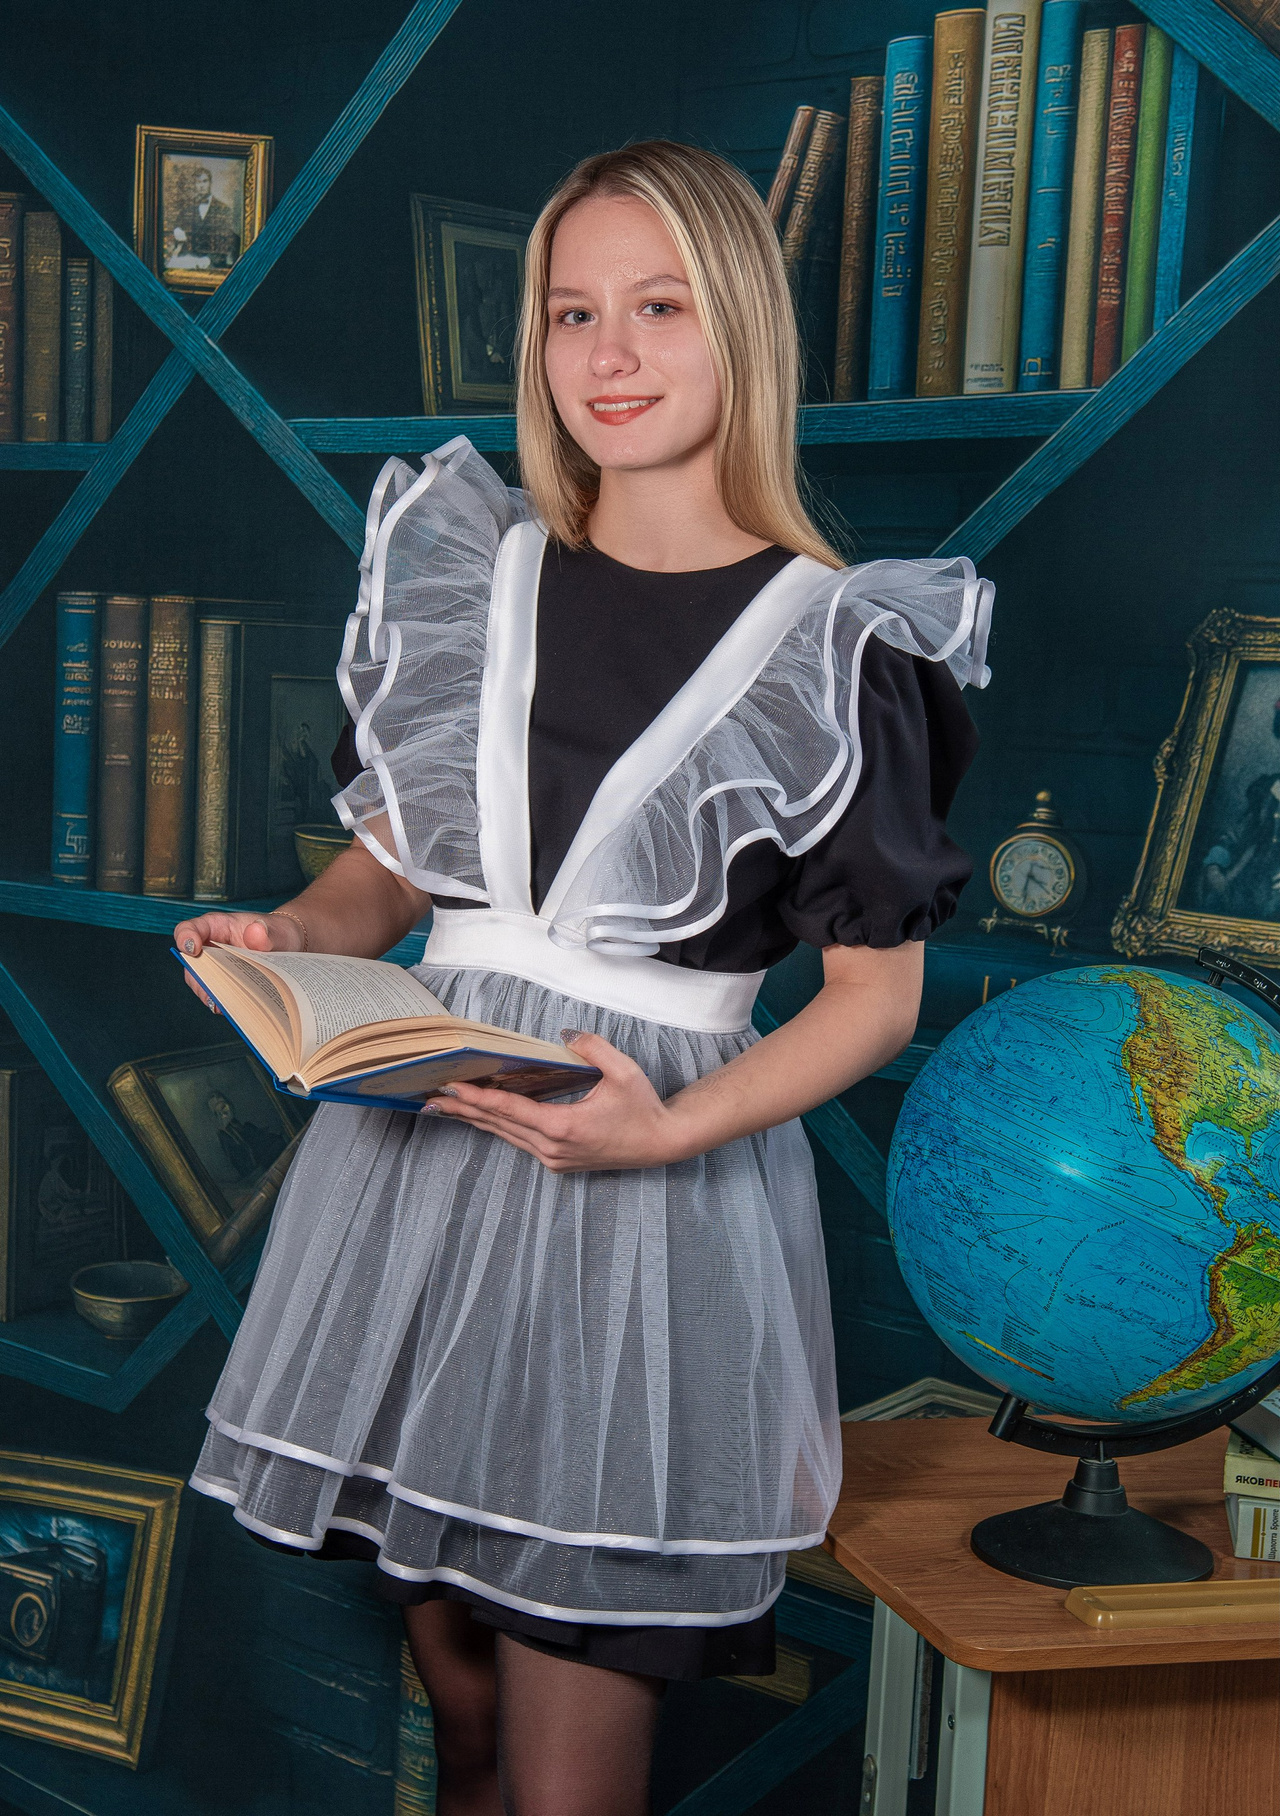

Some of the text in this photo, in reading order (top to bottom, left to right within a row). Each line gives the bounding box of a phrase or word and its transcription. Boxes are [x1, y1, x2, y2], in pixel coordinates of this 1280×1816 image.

[1235, 1474, 1280, 1488] ЯКОВПЕ
[1268, 1508, 1280, 1560] Шарлотта Бронте
